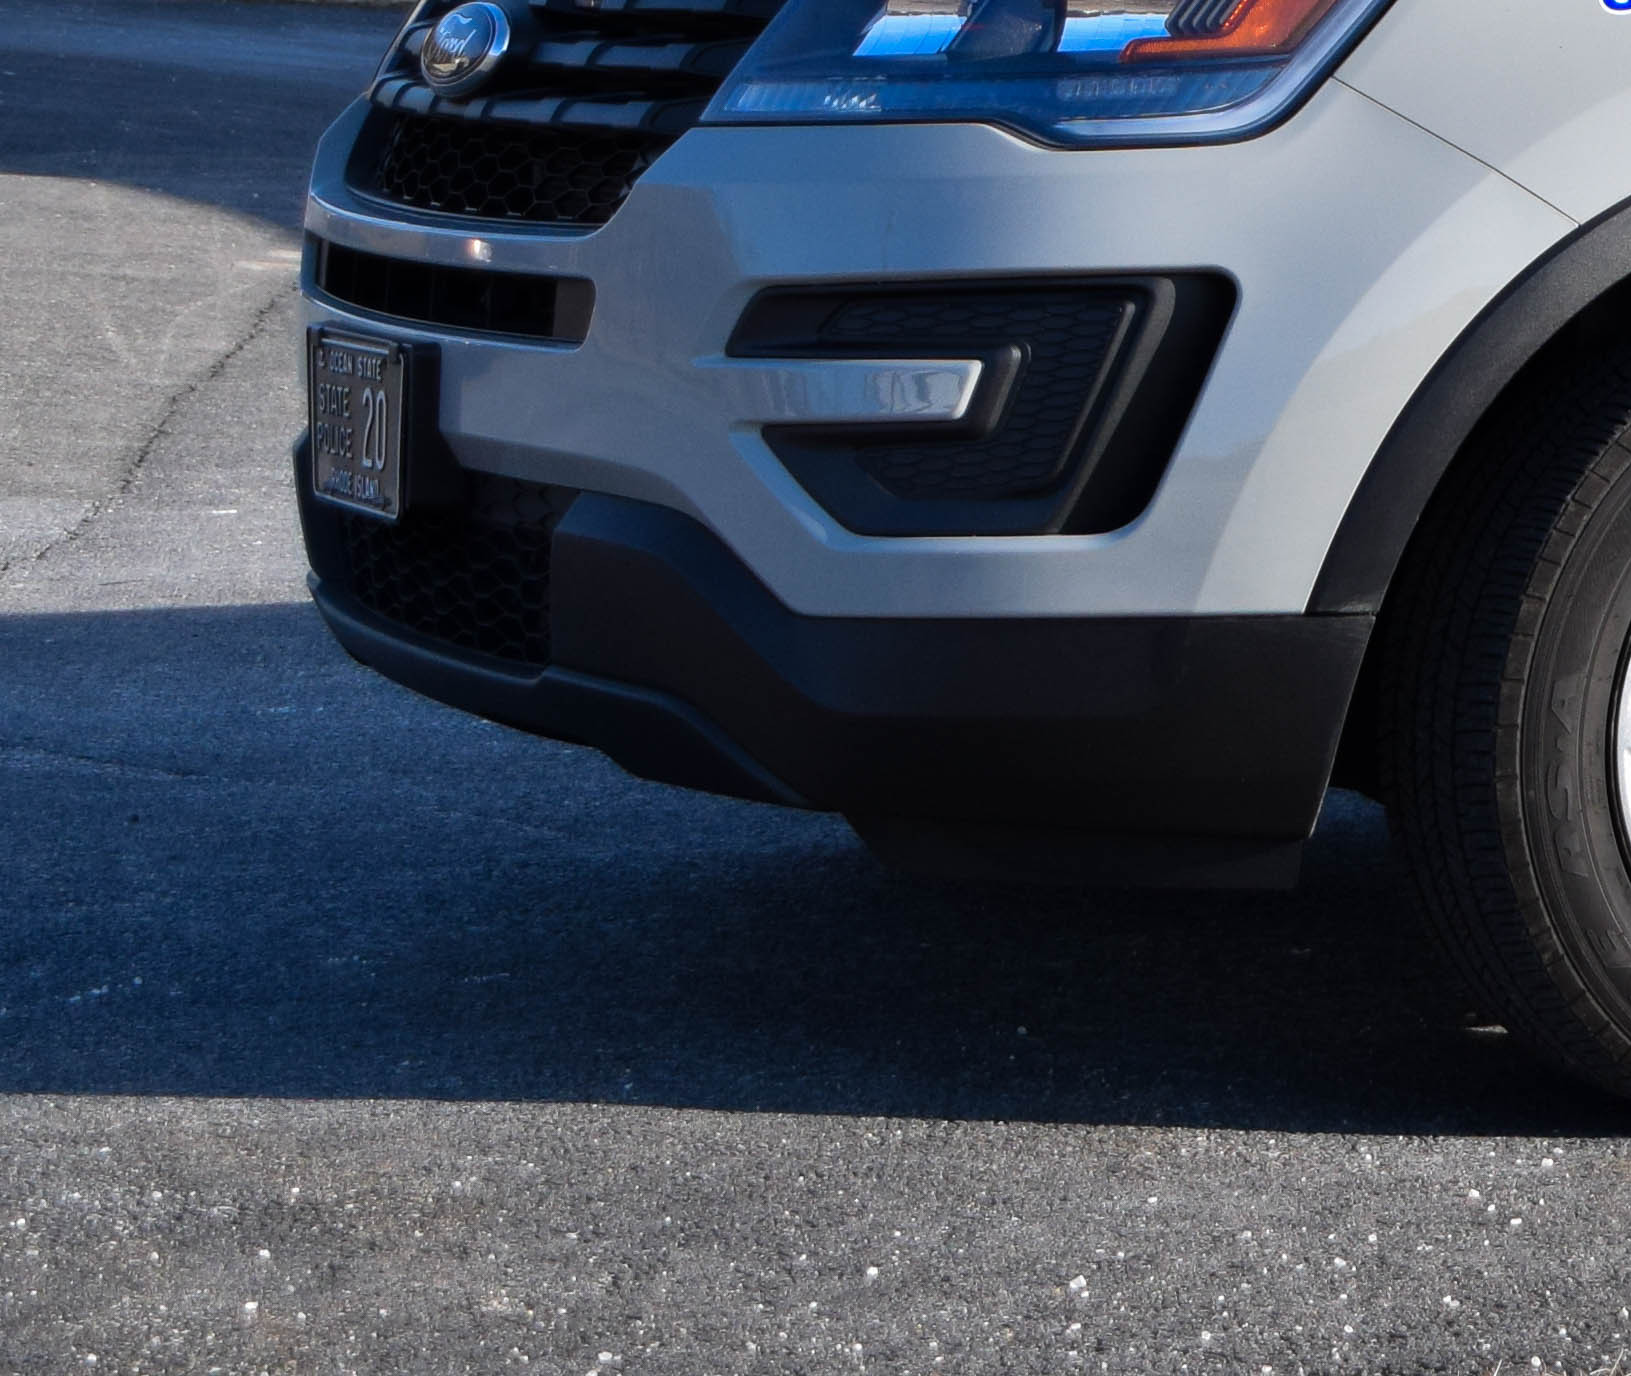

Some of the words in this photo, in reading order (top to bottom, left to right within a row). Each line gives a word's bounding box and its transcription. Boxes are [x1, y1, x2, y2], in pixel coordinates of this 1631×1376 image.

[329, 350, 353, 376] OCEAN
[358, 354, 382, 382] STATE
[319, 383, 350, 417] STATE
[317, 422, 353, 458] POLICE
[362, 387, 388, 471] 20
